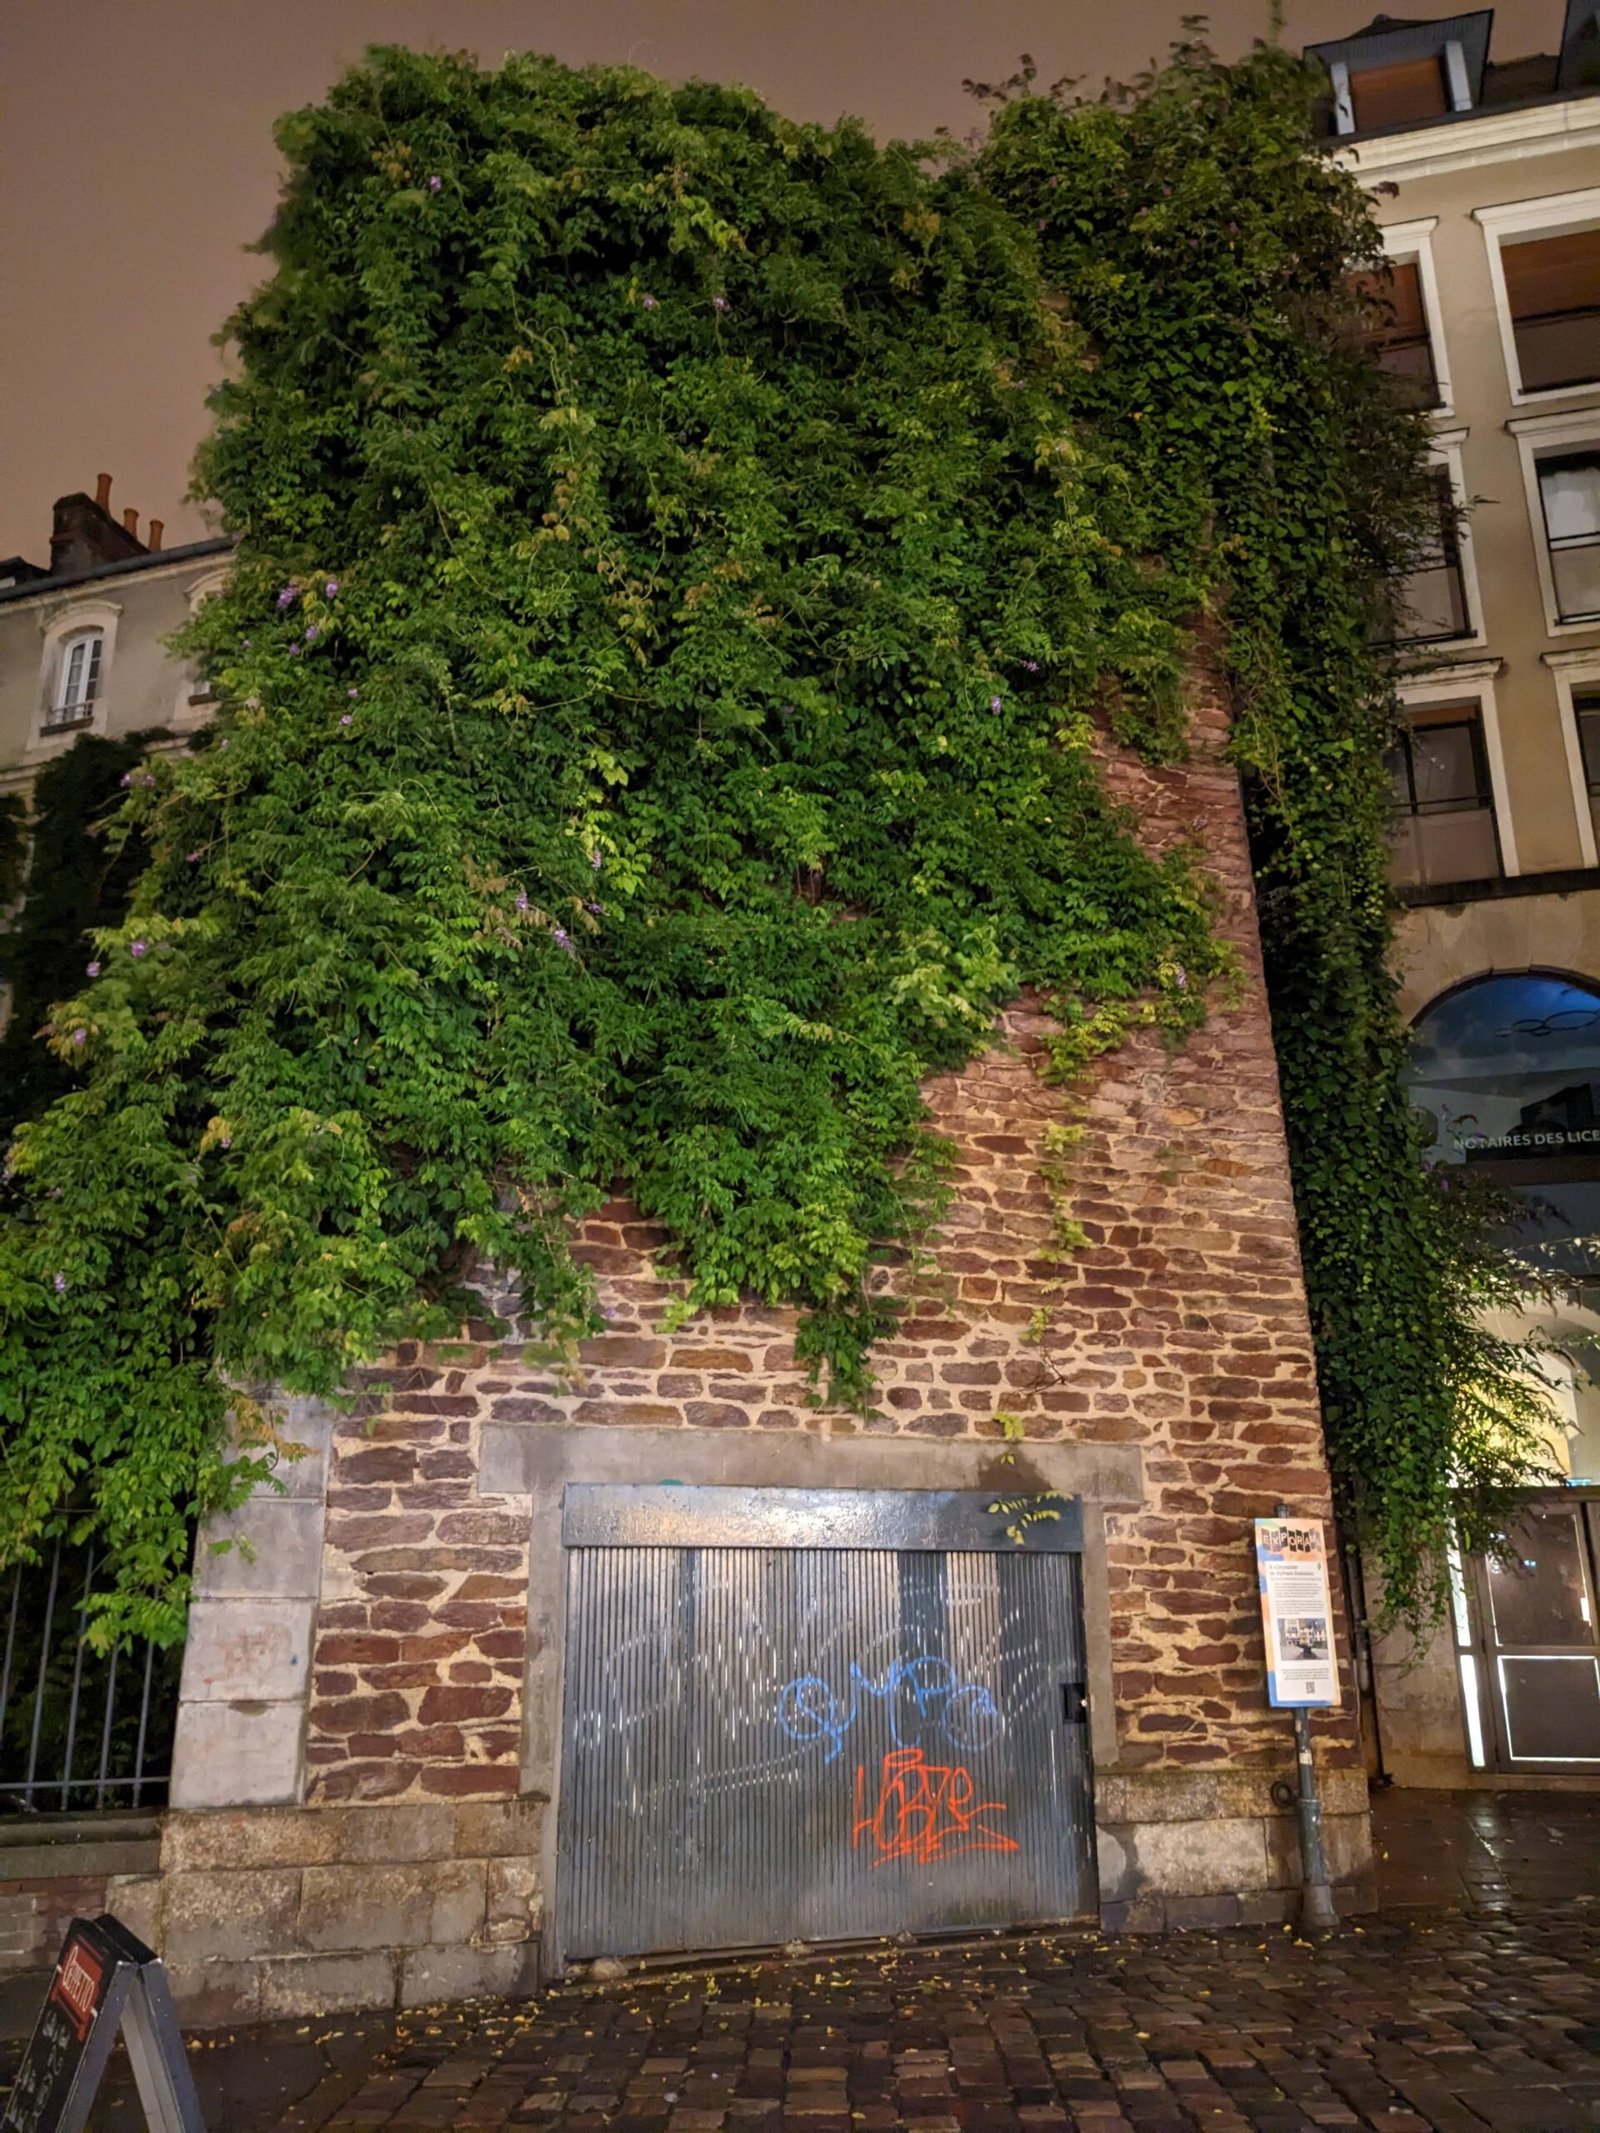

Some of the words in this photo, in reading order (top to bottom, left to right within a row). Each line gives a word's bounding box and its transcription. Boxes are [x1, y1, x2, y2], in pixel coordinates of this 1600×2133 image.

[1453, 1134, 1531, 1150] NOTAIRES
[1534, 1132, 1565, 1146] DES
[1261, 1529, 1322, 1551] EXPORAMA
